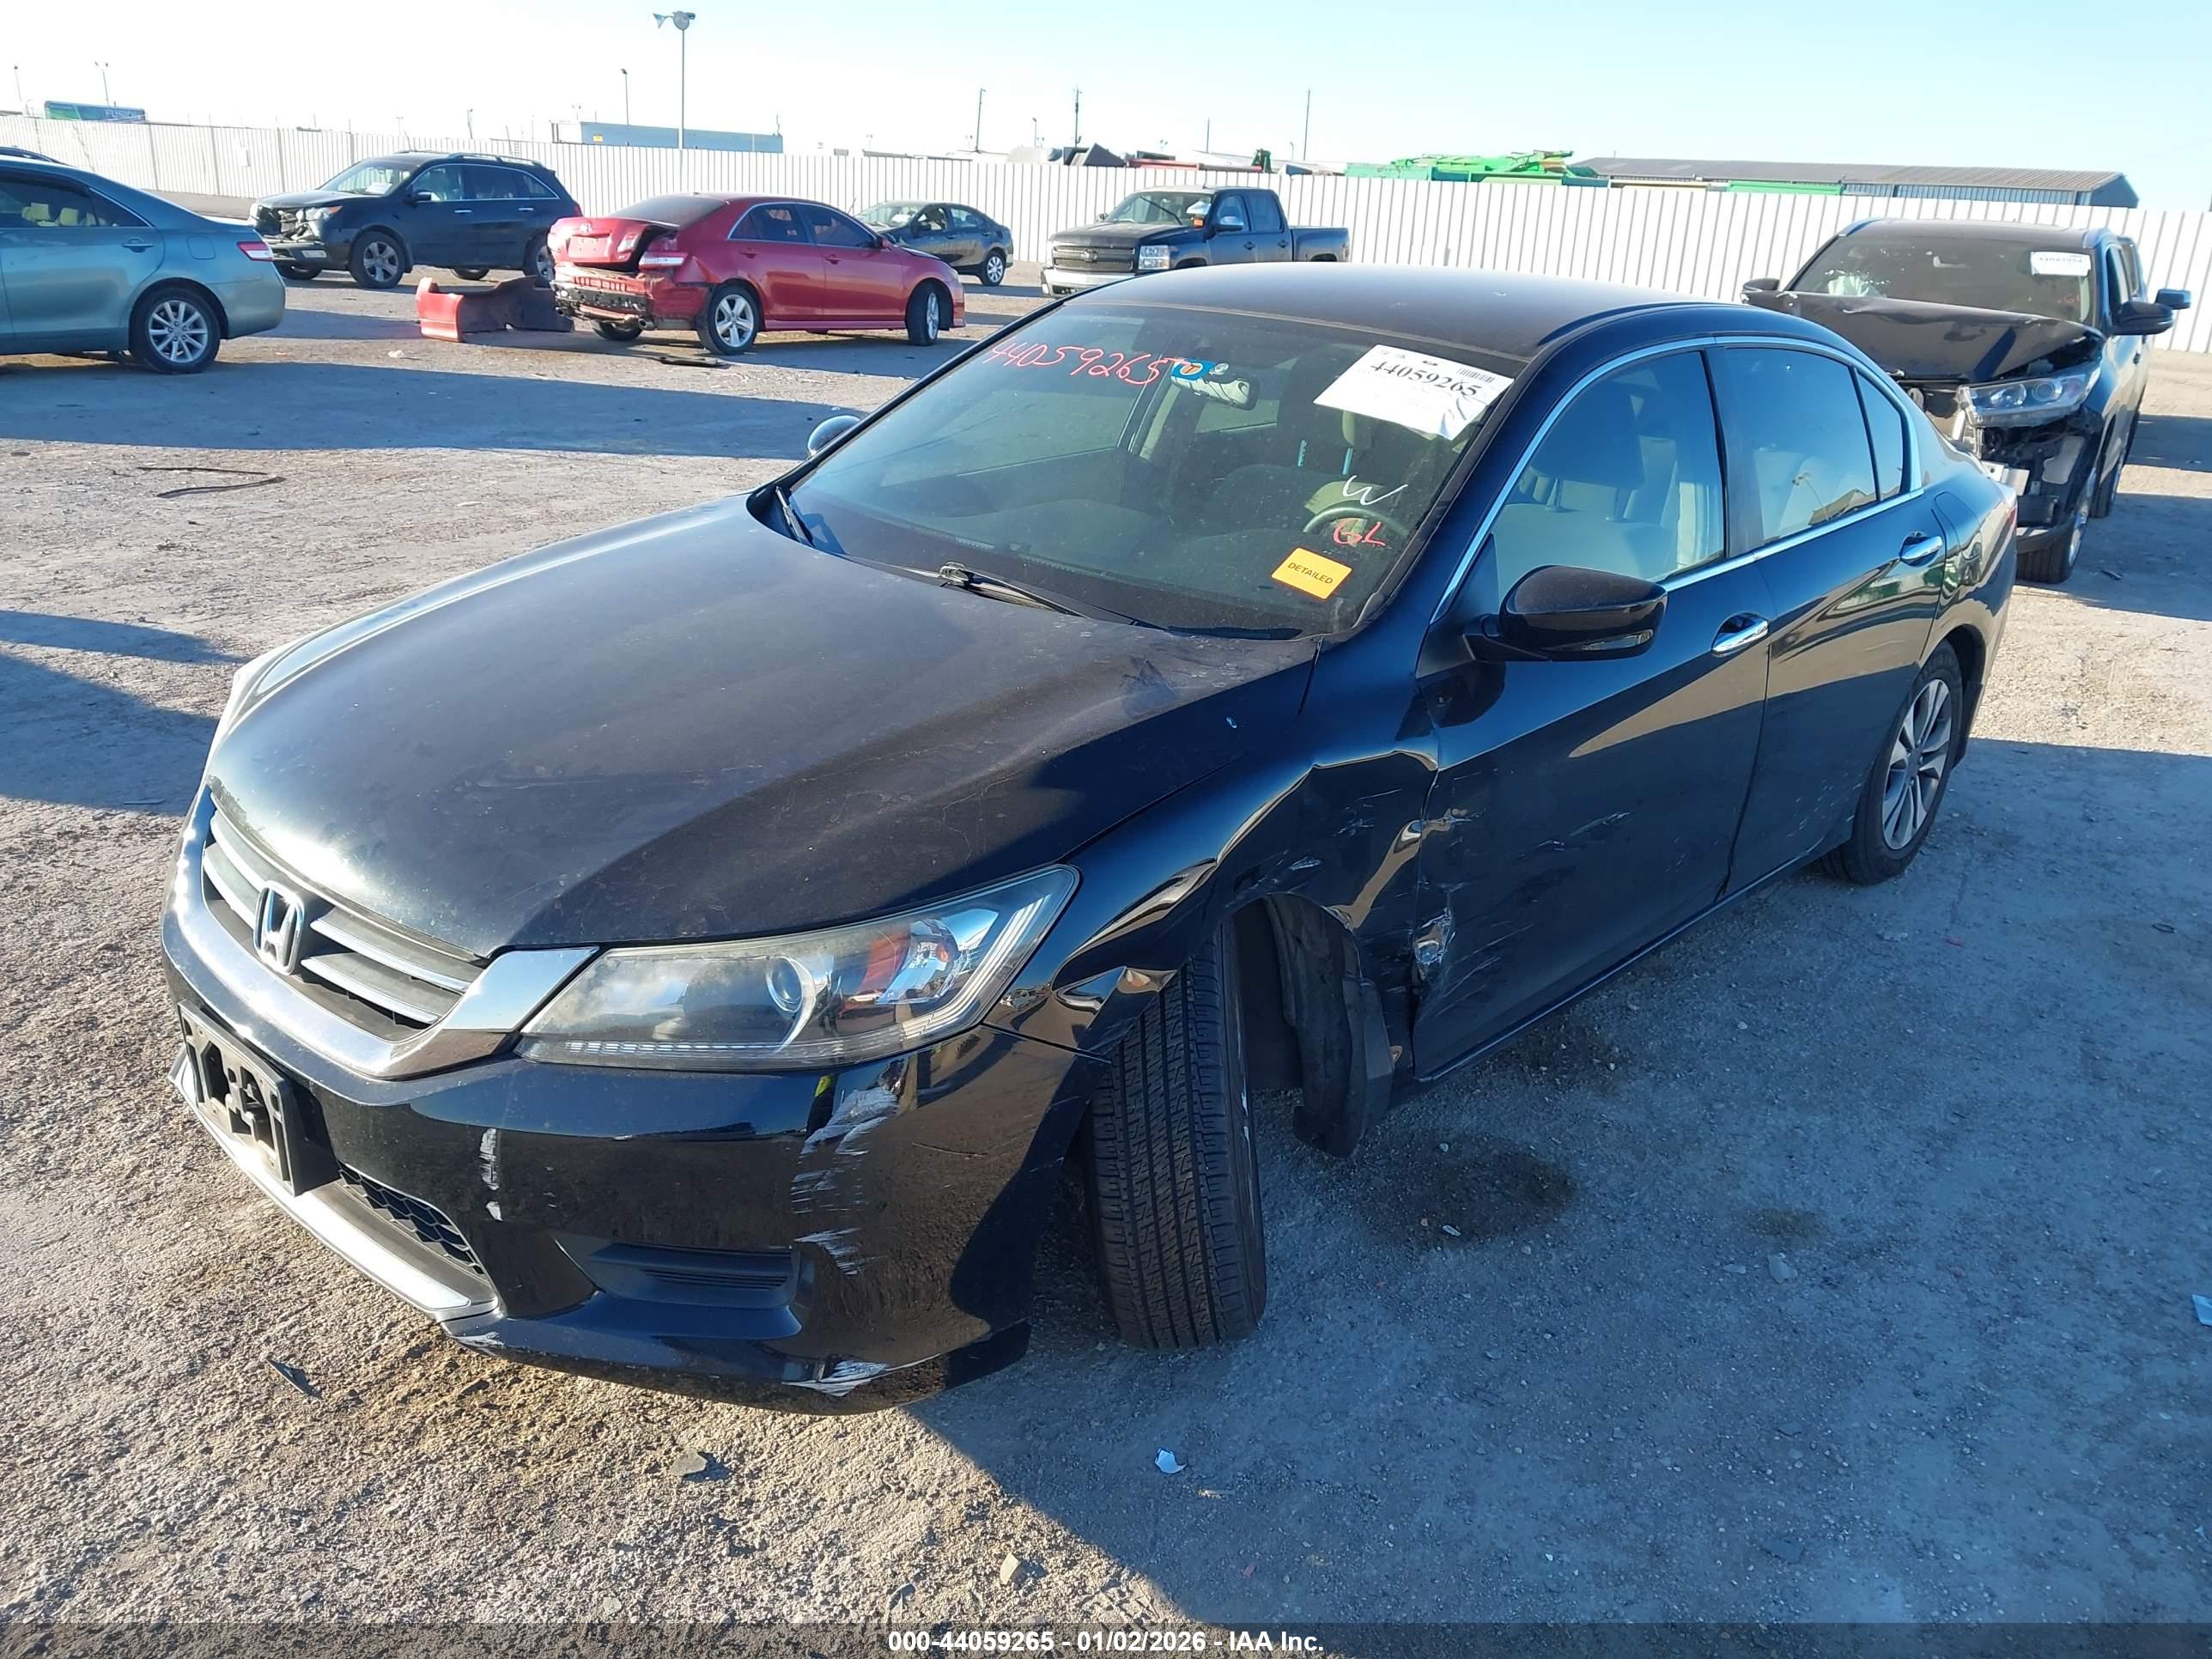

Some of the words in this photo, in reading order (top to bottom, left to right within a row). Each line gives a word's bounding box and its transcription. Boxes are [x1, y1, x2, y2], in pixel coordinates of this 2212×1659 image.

[982, 337, 1192, 384] 44059265
[1370, 361, 1482, 398] 44059265
[1333, 519, 1386, 545] GL
[1287, 561, 1334, 585] DETAILED
